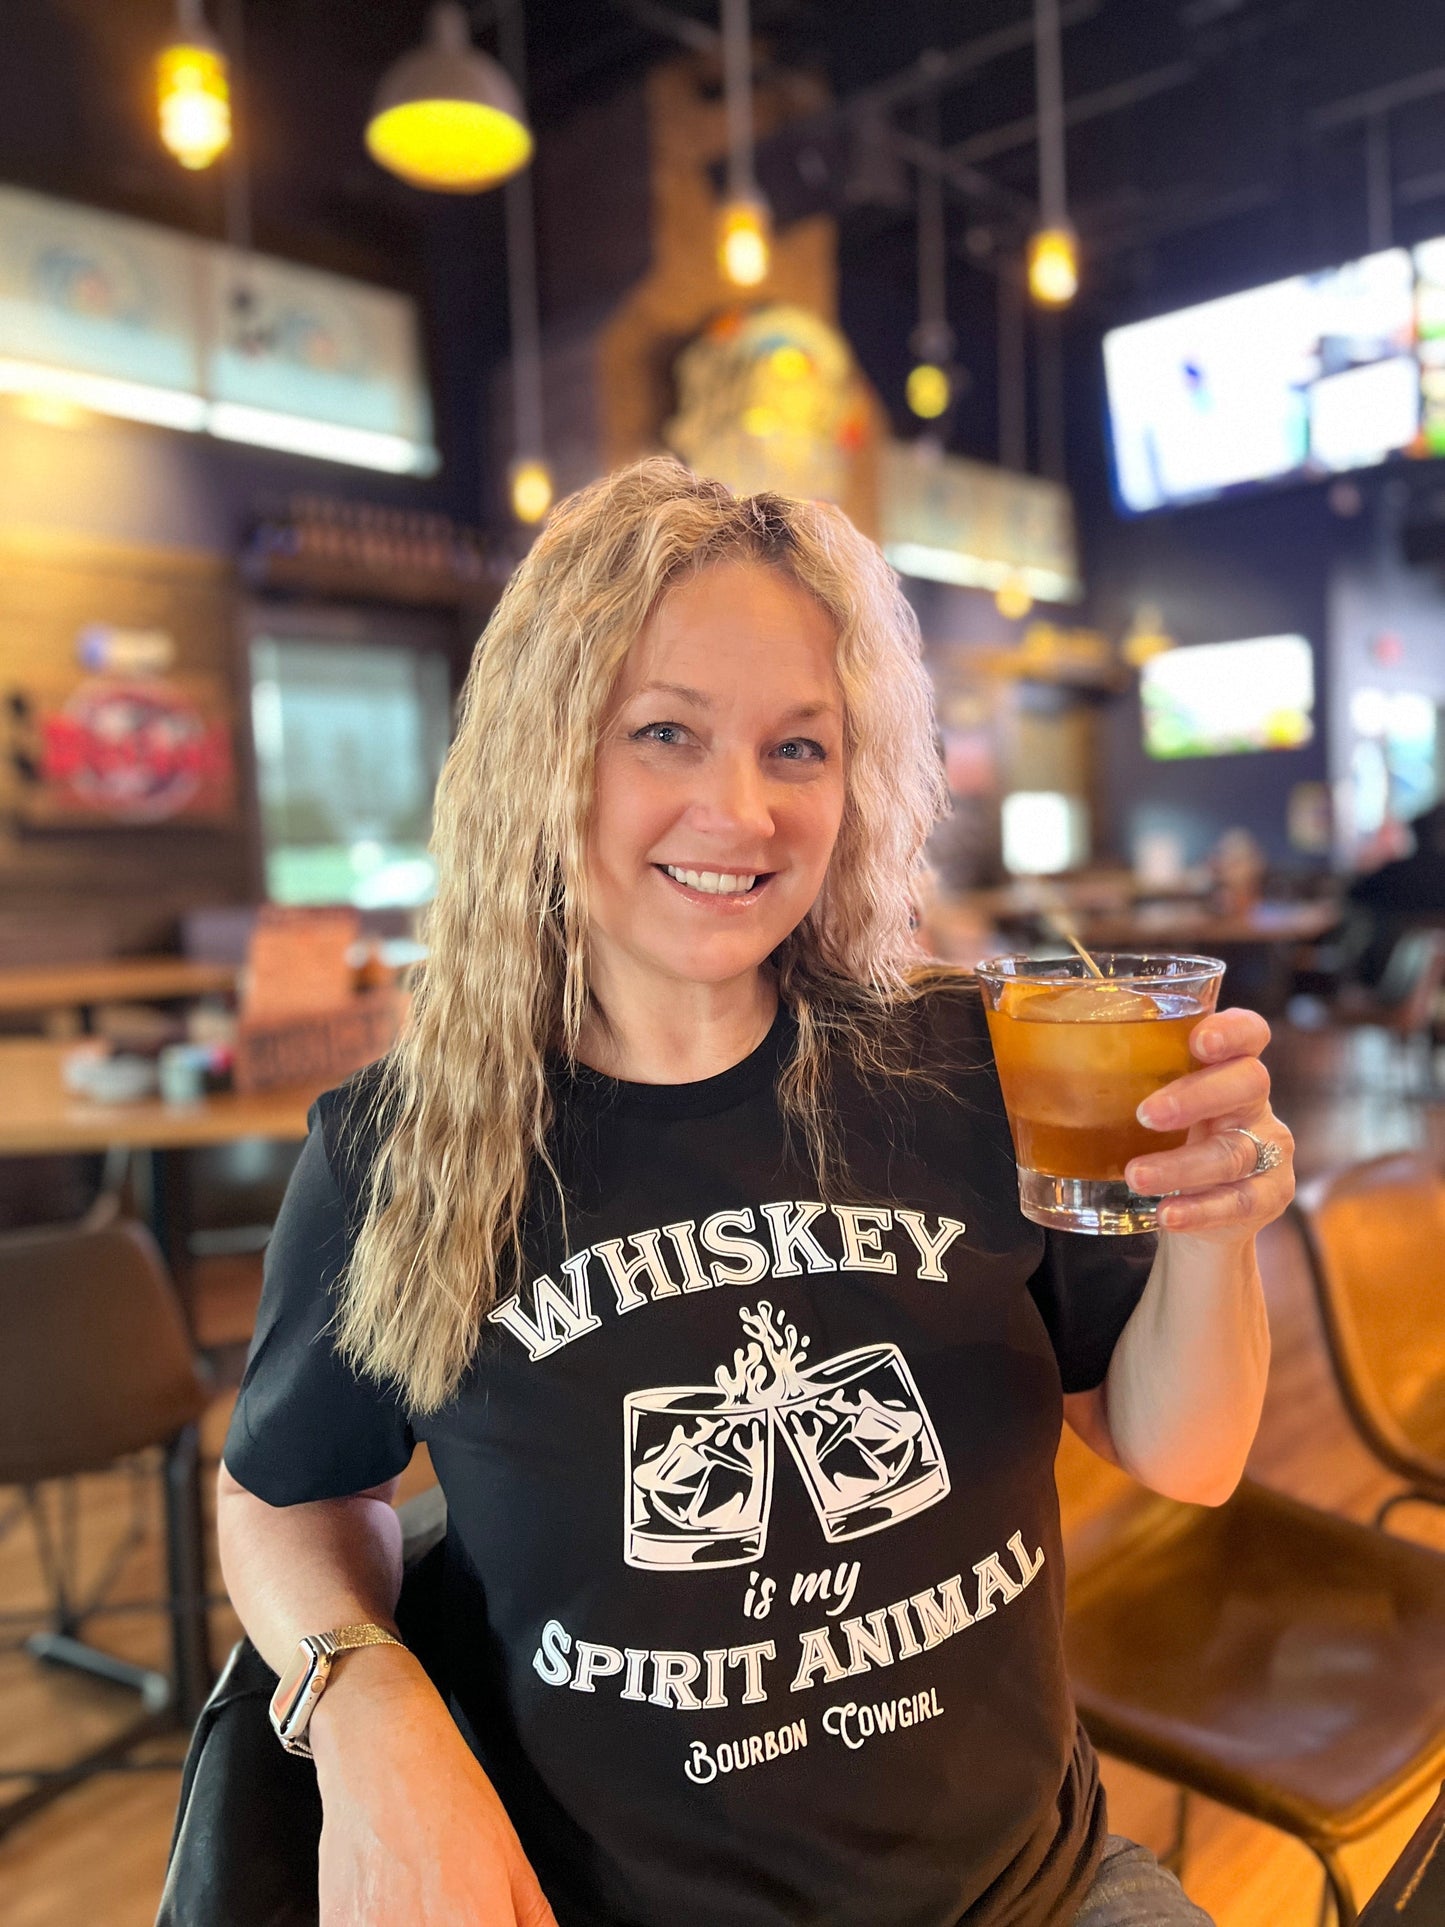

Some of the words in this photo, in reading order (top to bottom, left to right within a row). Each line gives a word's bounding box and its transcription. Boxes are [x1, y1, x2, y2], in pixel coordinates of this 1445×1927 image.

[488, 1201, 966, 1362] WHISKEY
[533, 1620, 776, 1710] SPIRIT
[789, 1530, 1044, 1692] ANIMAL
[743, 1571, 776, 1620] is
[790, 1561, 862, 1616] my
[685, 1718, 808, 1785] BOURBON
[823, 1688, 944, 1750] COWGIRL
